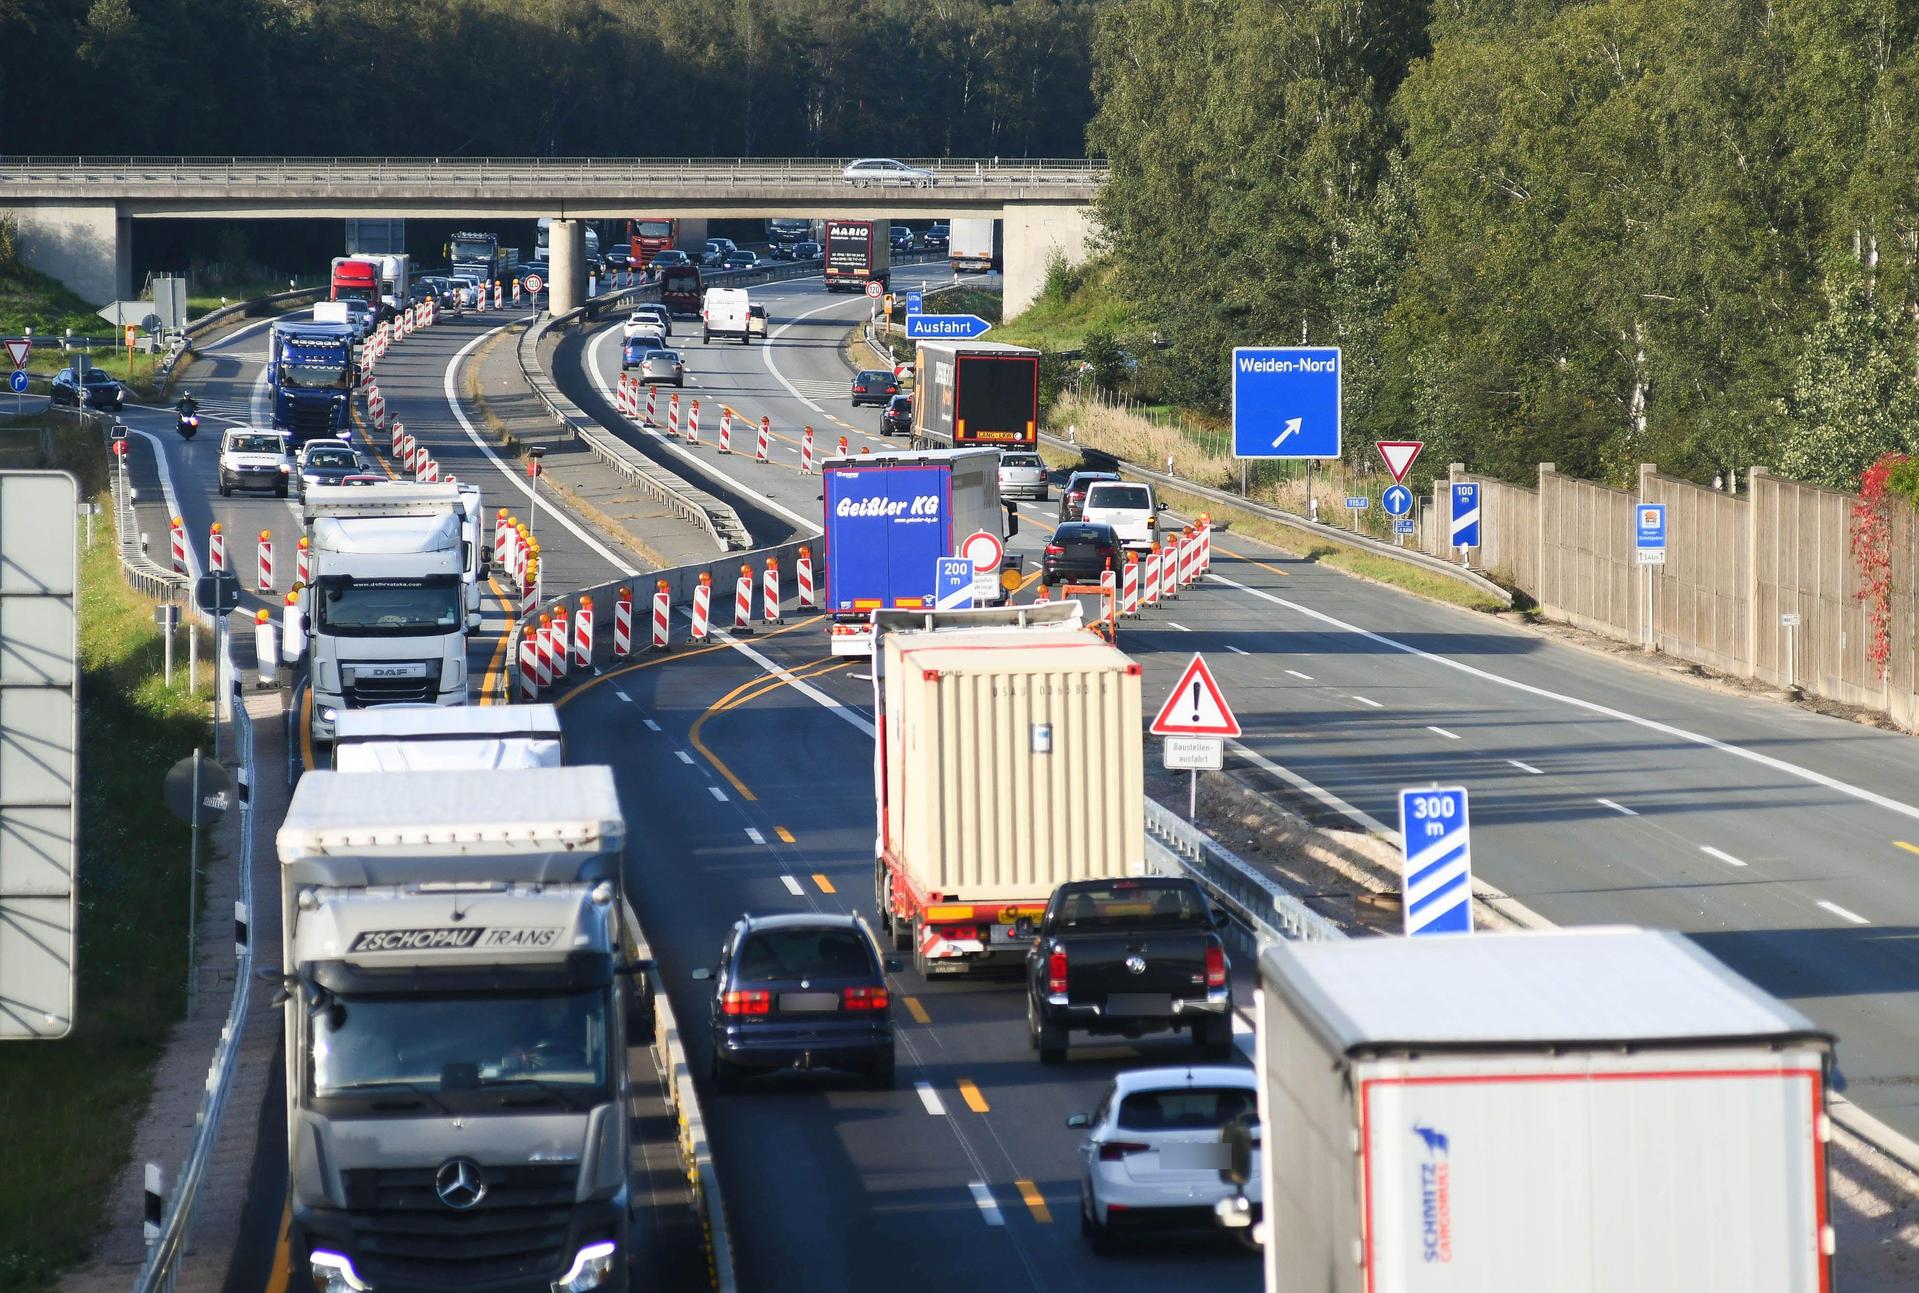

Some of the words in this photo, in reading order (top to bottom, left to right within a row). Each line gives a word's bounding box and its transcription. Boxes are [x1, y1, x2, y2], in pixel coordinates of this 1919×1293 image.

[830, 227, 869, 237] MARIO
[529, 280, 539, 288] 120
[869, 285, 880, 294] 120
[914, 321, 972, 333] Ausfahrt
[1240, 357, 1336, 372] Weiden-Nord
[1457, 486, 1473, 496] 100
[836, 497, 908, 517] Geißler
[910, 496, 939, 515] KG
[944, 562, 968, 575] 200
[950, 576, 960, 585] m
[373, 668, 408, 677] DAF
[1173, 743, 1214, 752] Baustellen-
[1413, 796, 1455, 819] 300
[1426, 821, 1444, 837] m
[354, 929, 476, 951] ZSCHOPAU
[485, 929, 556, 946] TRANS
[1421, 1163, 1439, 1263] SCHMITZ
